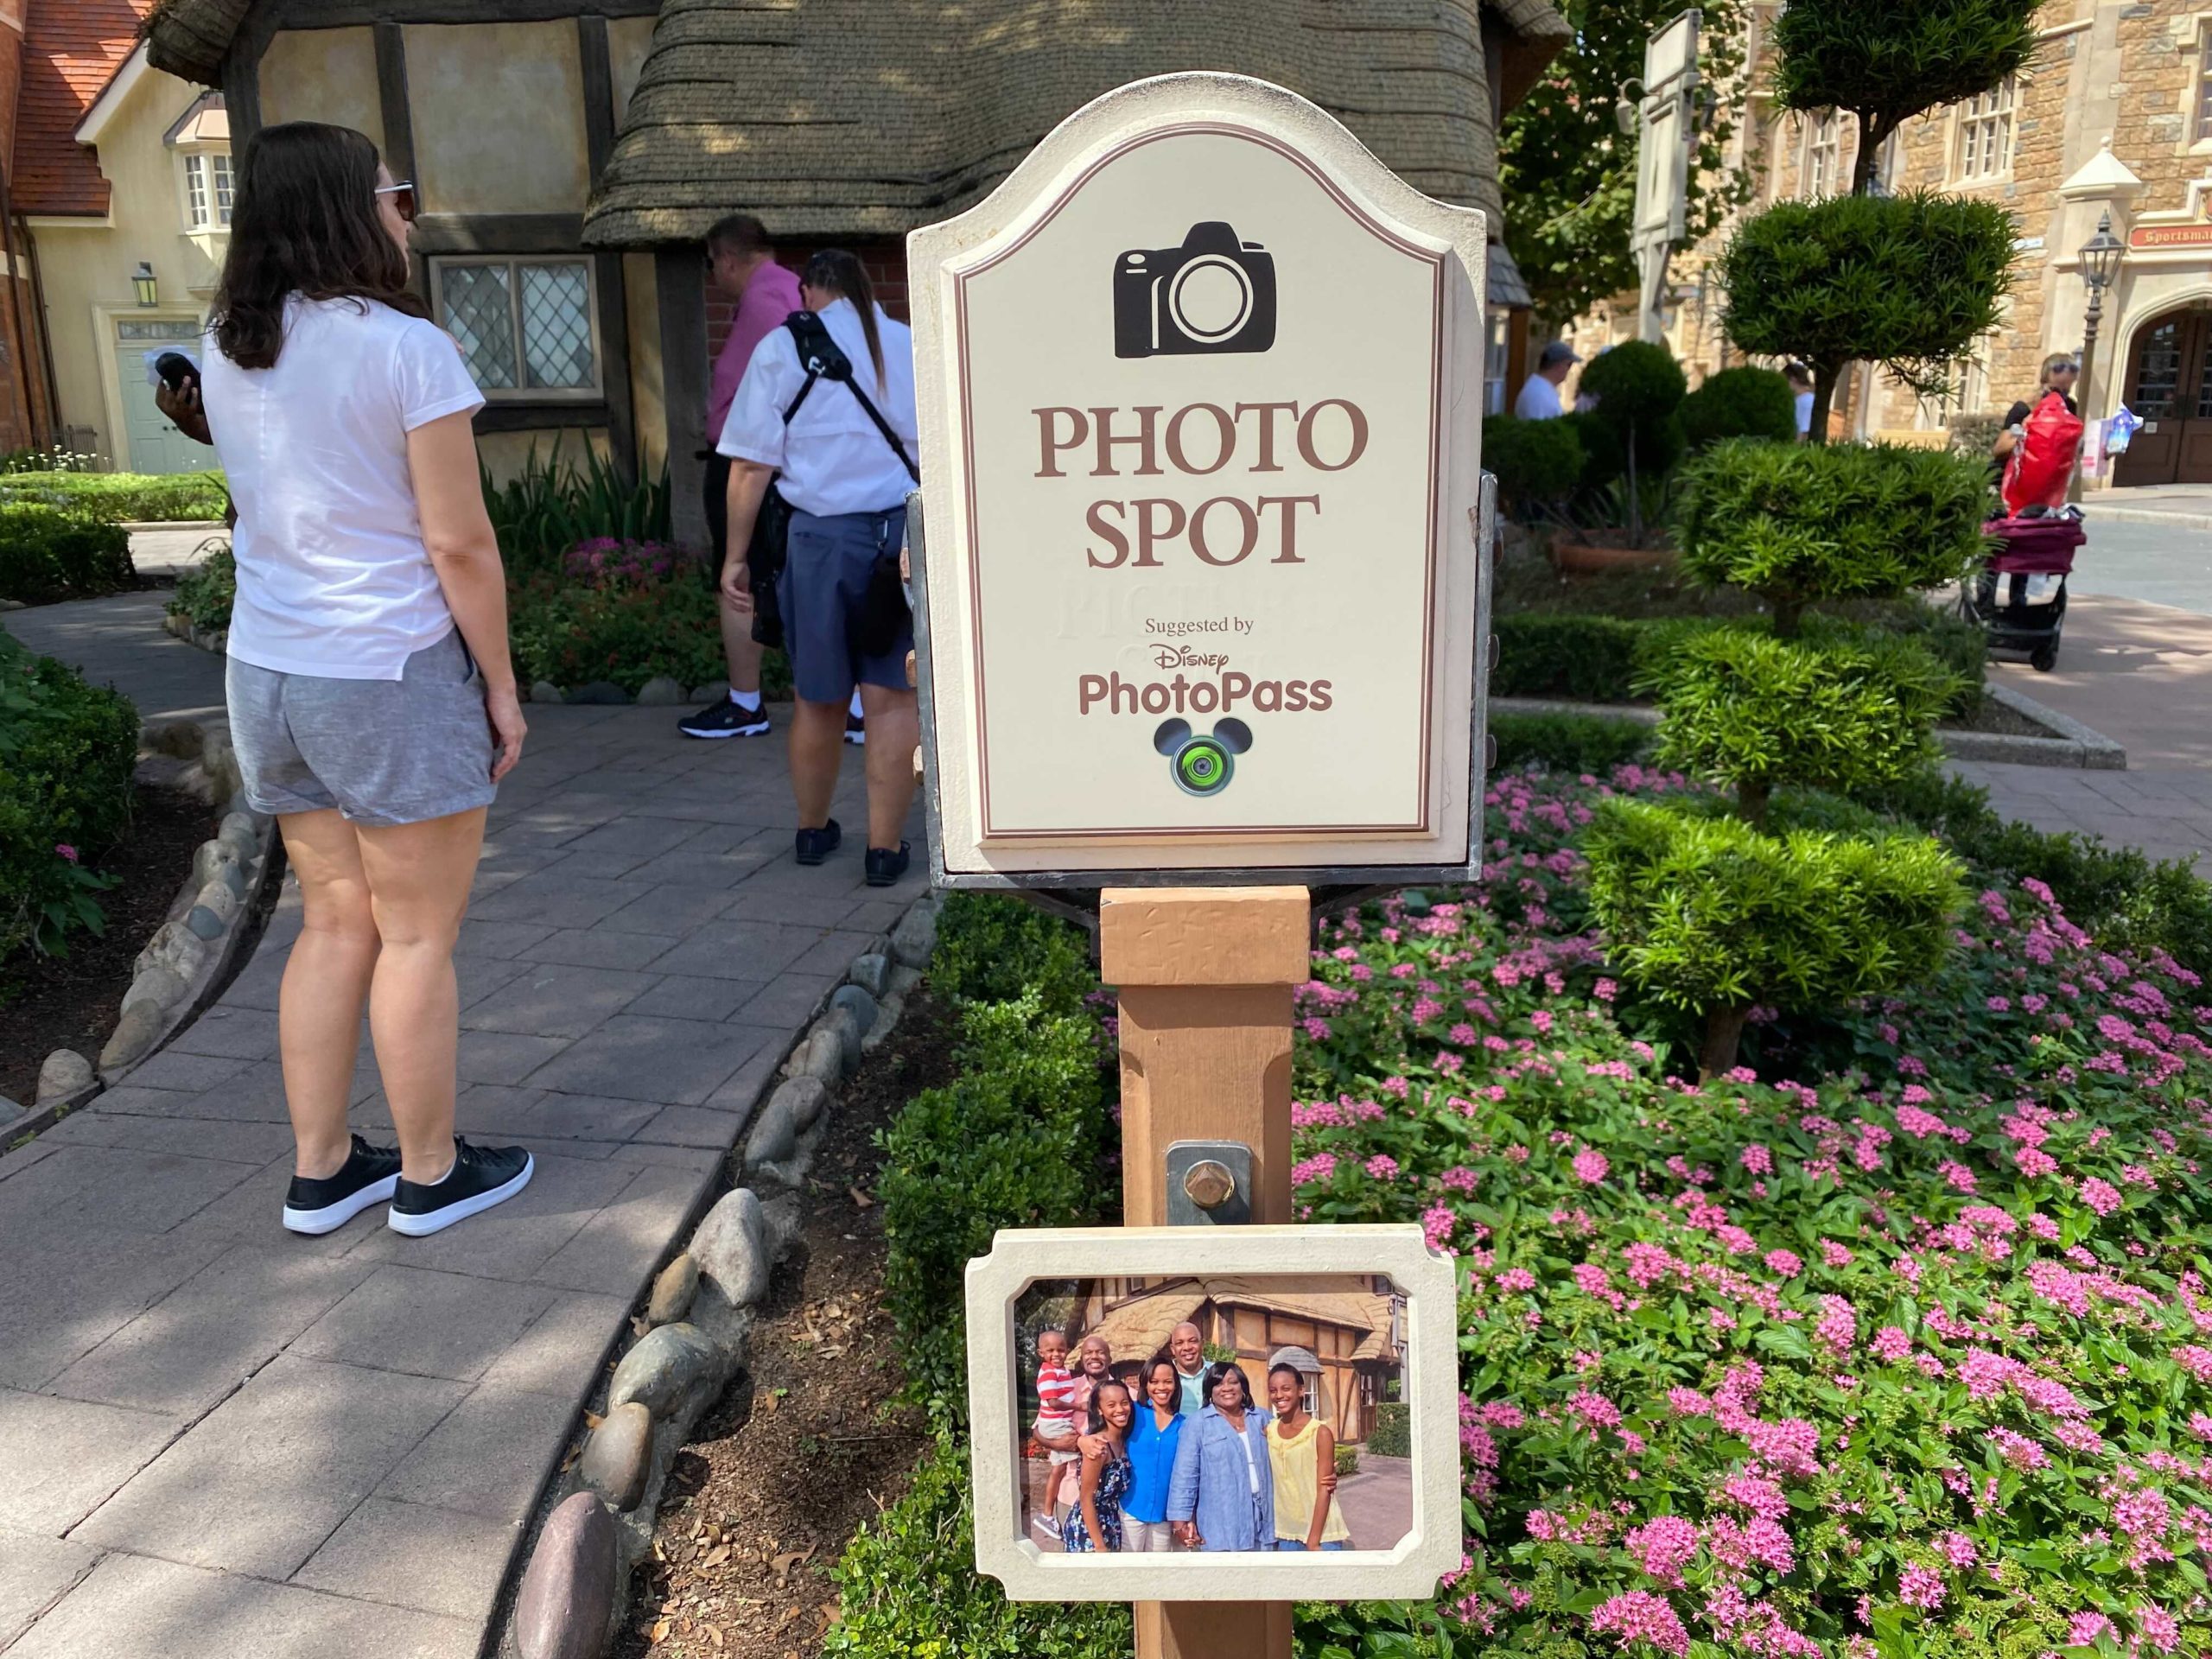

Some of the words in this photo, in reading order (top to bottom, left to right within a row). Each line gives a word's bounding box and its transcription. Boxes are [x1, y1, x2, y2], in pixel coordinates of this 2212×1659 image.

[2145, 229, 2212, 244] Sportsma
[1031, 398, 1369, 478] PHOTO
[1085, 493, 1321, 569] SPOT
[1145, 616, 1229, 637] Suggested
[1234, 615, 1255, 635] by
[1079, 671, 1333, 715] PhotoPass
